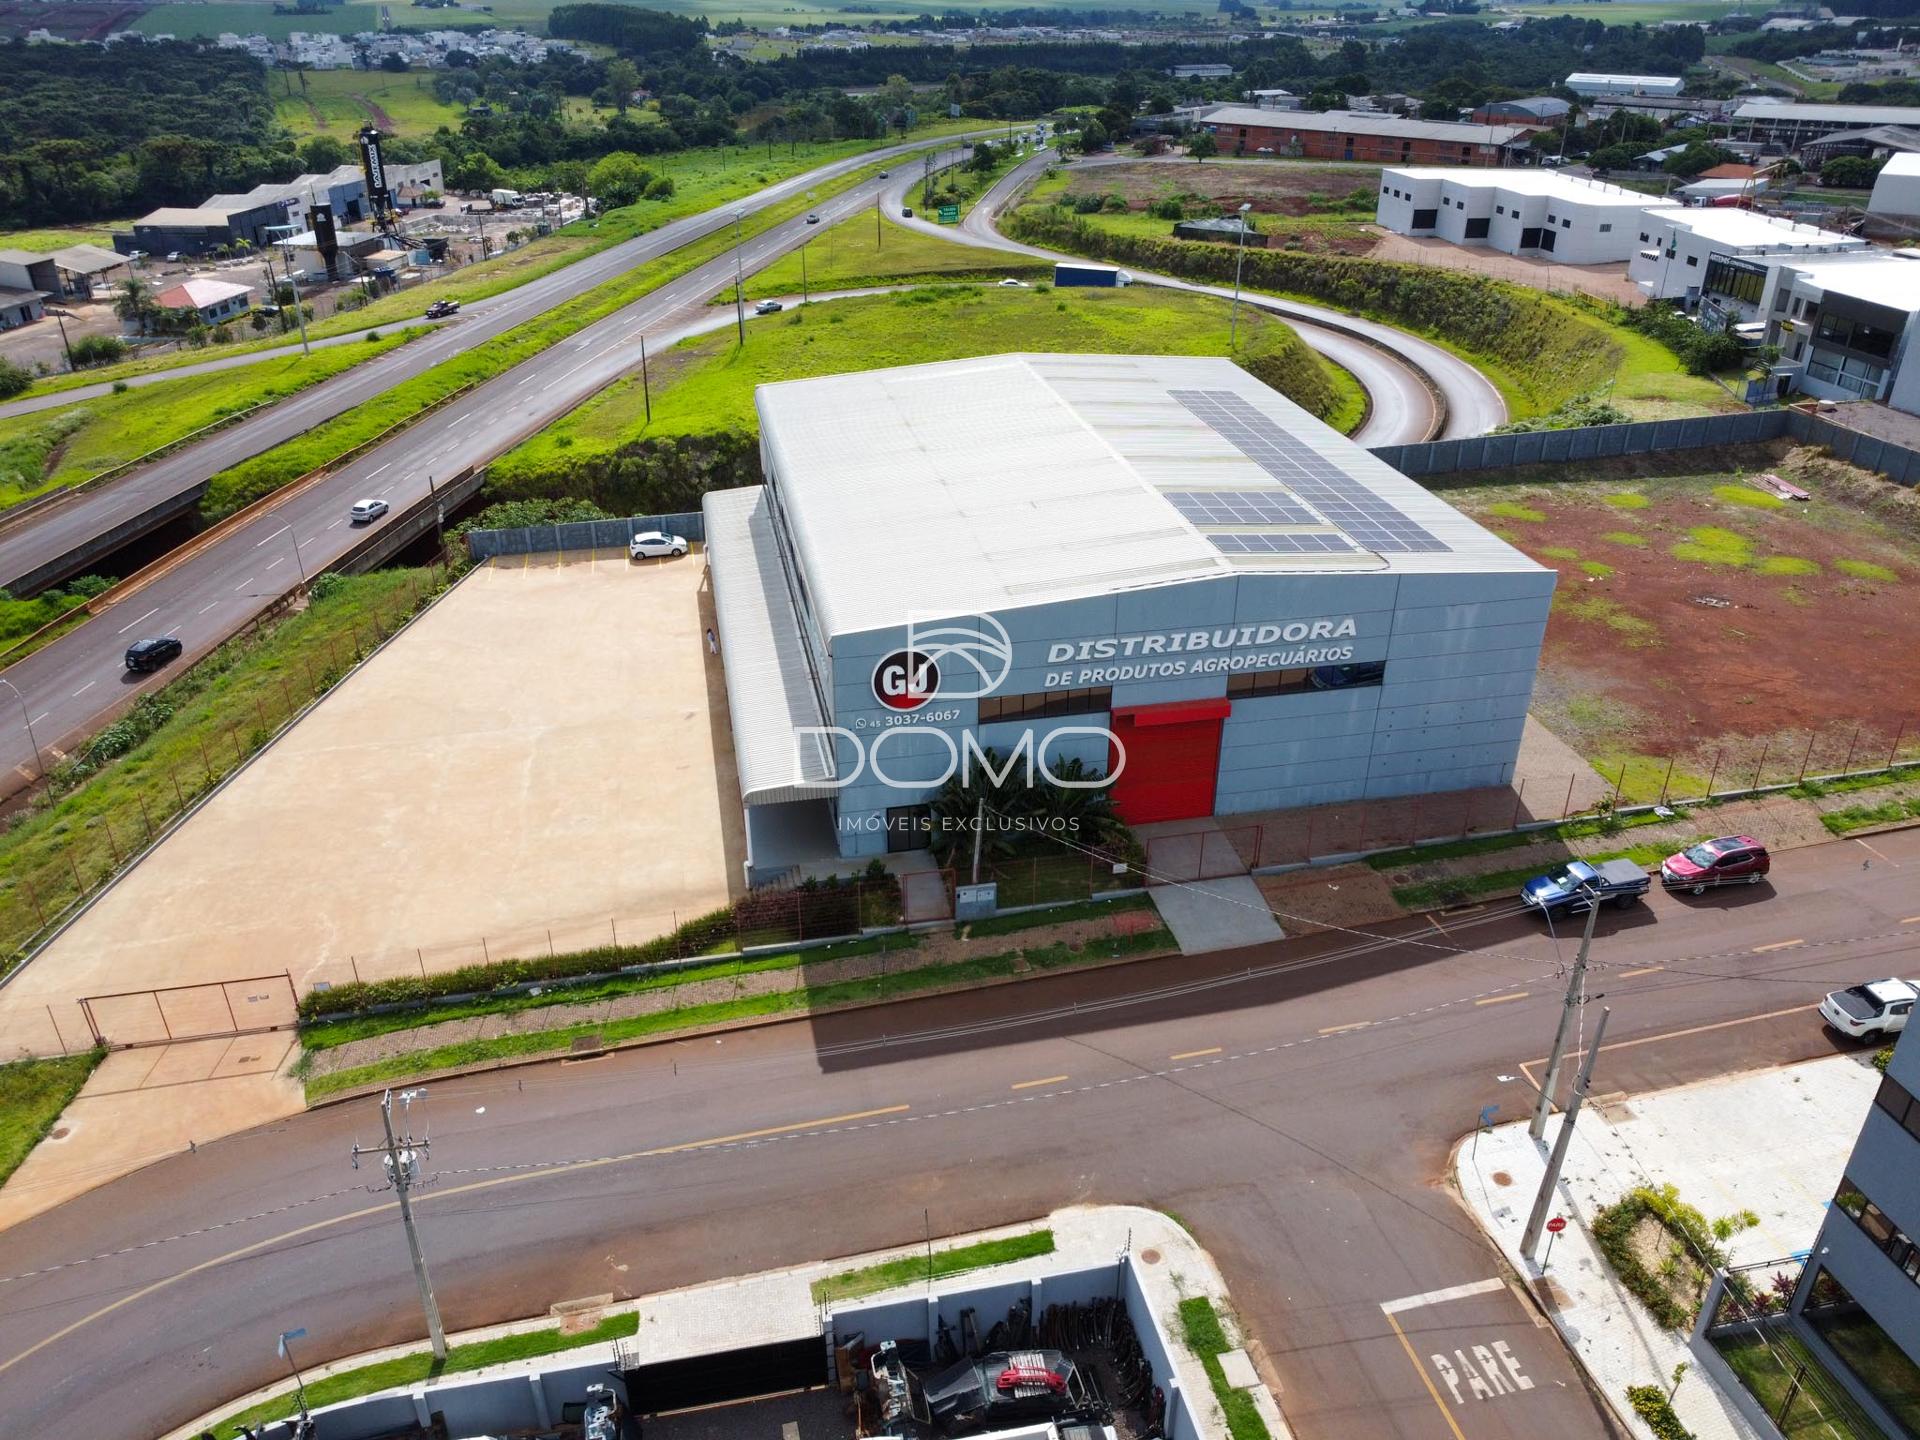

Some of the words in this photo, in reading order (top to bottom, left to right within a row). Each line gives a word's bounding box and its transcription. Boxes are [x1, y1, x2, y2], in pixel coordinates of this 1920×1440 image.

[1047, 618, 1357, 663] DISTRIBUIDORA
[1044, 671, 1073, 687] DE
[1078, 660, 1187, 684] PRODUTOS
[1191, 646, 1354, 674] AGROPECUÁRIOS
[869, 720, 881, 728] 45
[885, 709, 960, 727] 3037-6067
[1430, 1340, 1536, 1404] PARE
